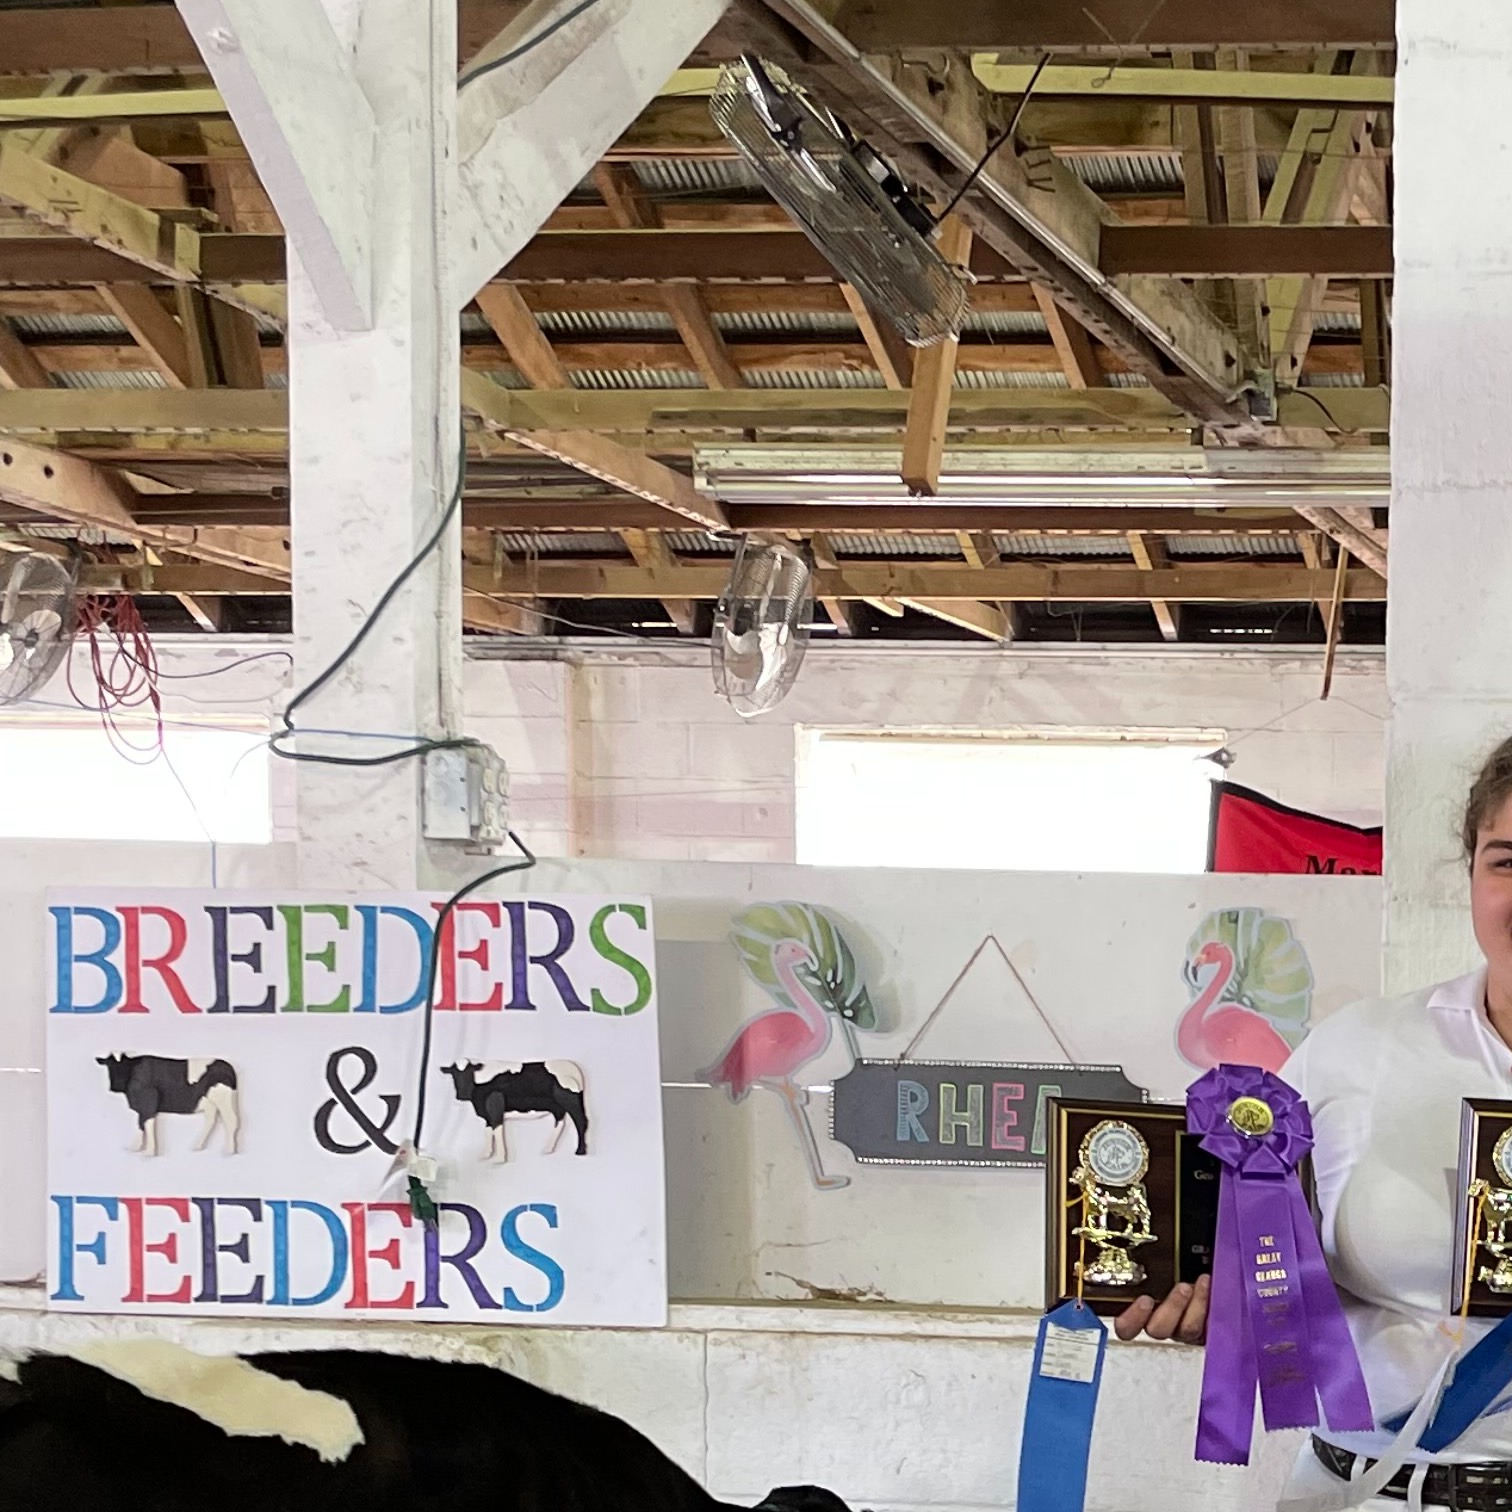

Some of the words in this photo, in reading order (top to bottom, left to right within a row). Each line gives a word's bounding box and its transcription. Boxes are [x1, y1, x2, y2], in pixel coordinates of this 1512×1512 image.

[48, 901, 653, 1016] BREEDERS
[314, 1046, 403, 1155] &
[49, 1194, 566, 1312] FEEDERS
